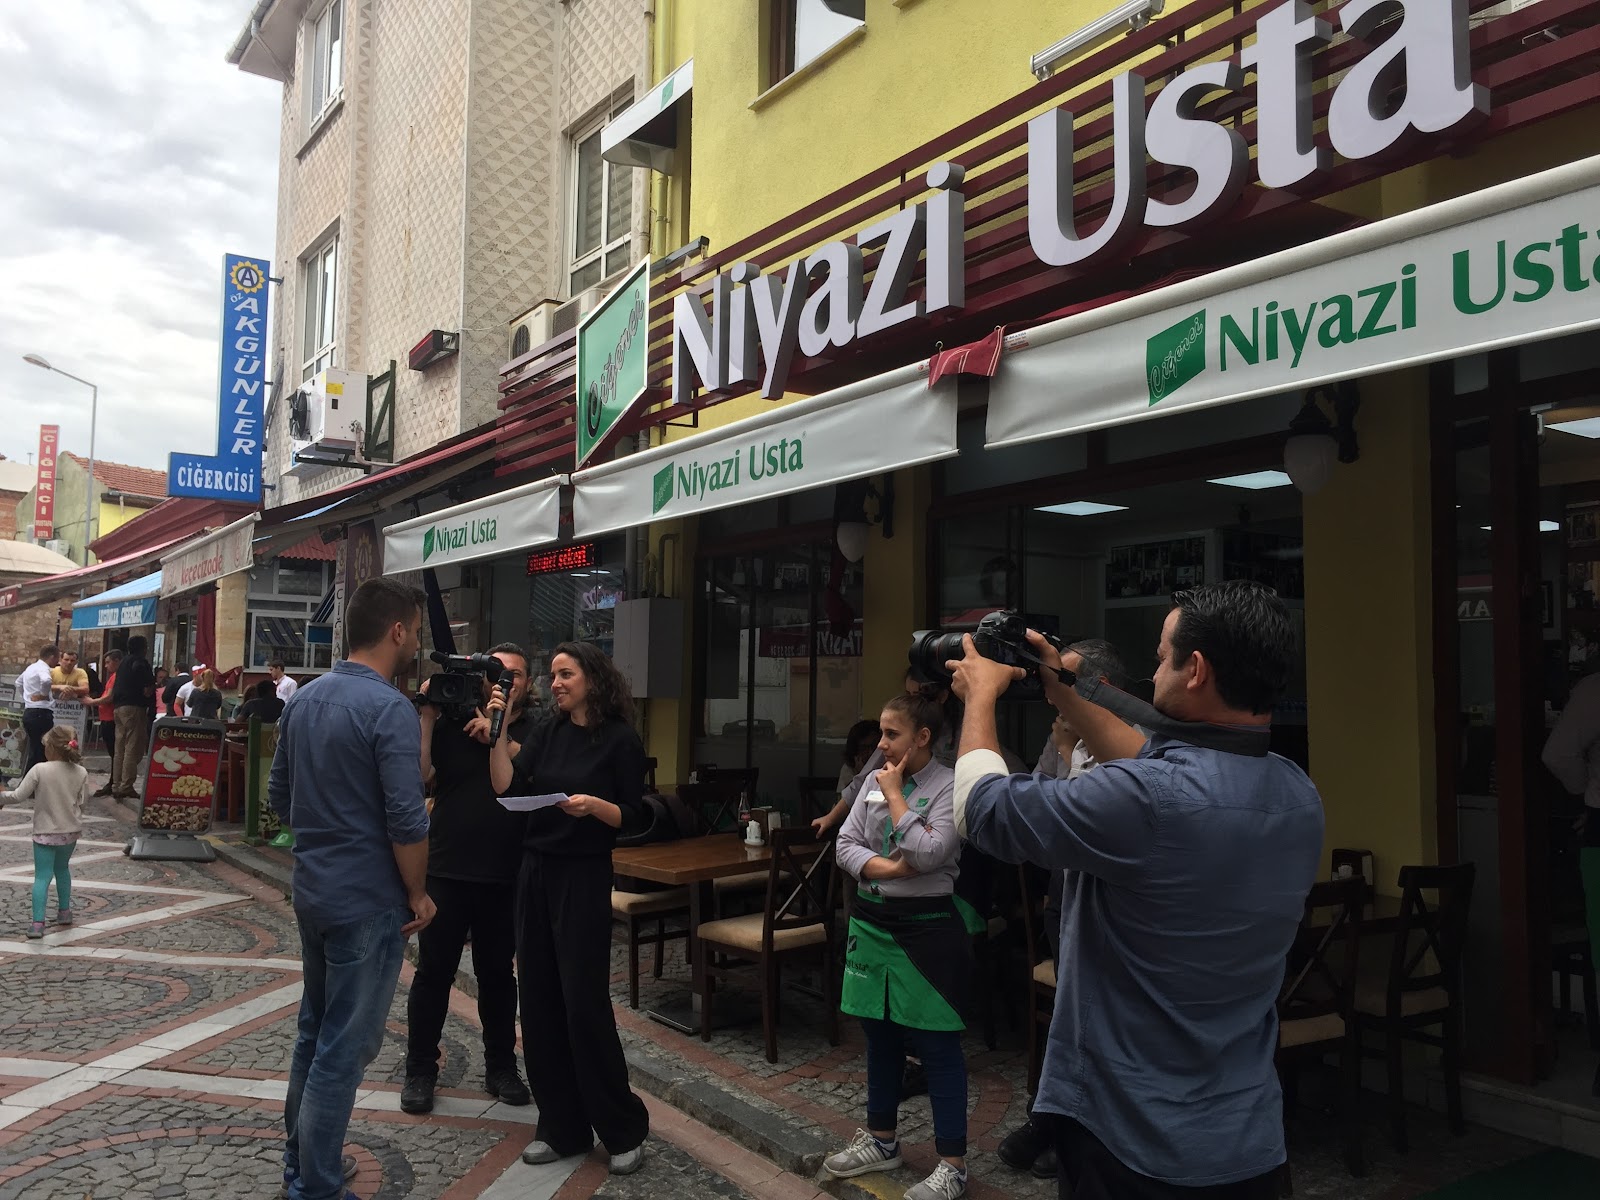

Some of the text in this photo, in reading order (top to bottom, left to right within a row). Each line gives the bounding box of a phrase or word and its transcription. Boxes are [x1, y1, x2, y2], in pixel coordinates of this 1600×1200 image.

[672, 0, 1489, 406] Niyazi Usta
[230, 292, 243, 303] ÖZ
[1220, 223, 1600, 372] Niyazi Ust
[231, 297, 261, 455] AKGÜNLER
[177, 462, 254, 493] CİĞERCİSİ
[677, 449, 740, 501] Niyazi
[750, 438, 803, 480] Usta
[435, 518, 497, 555] Niyazi Usta
